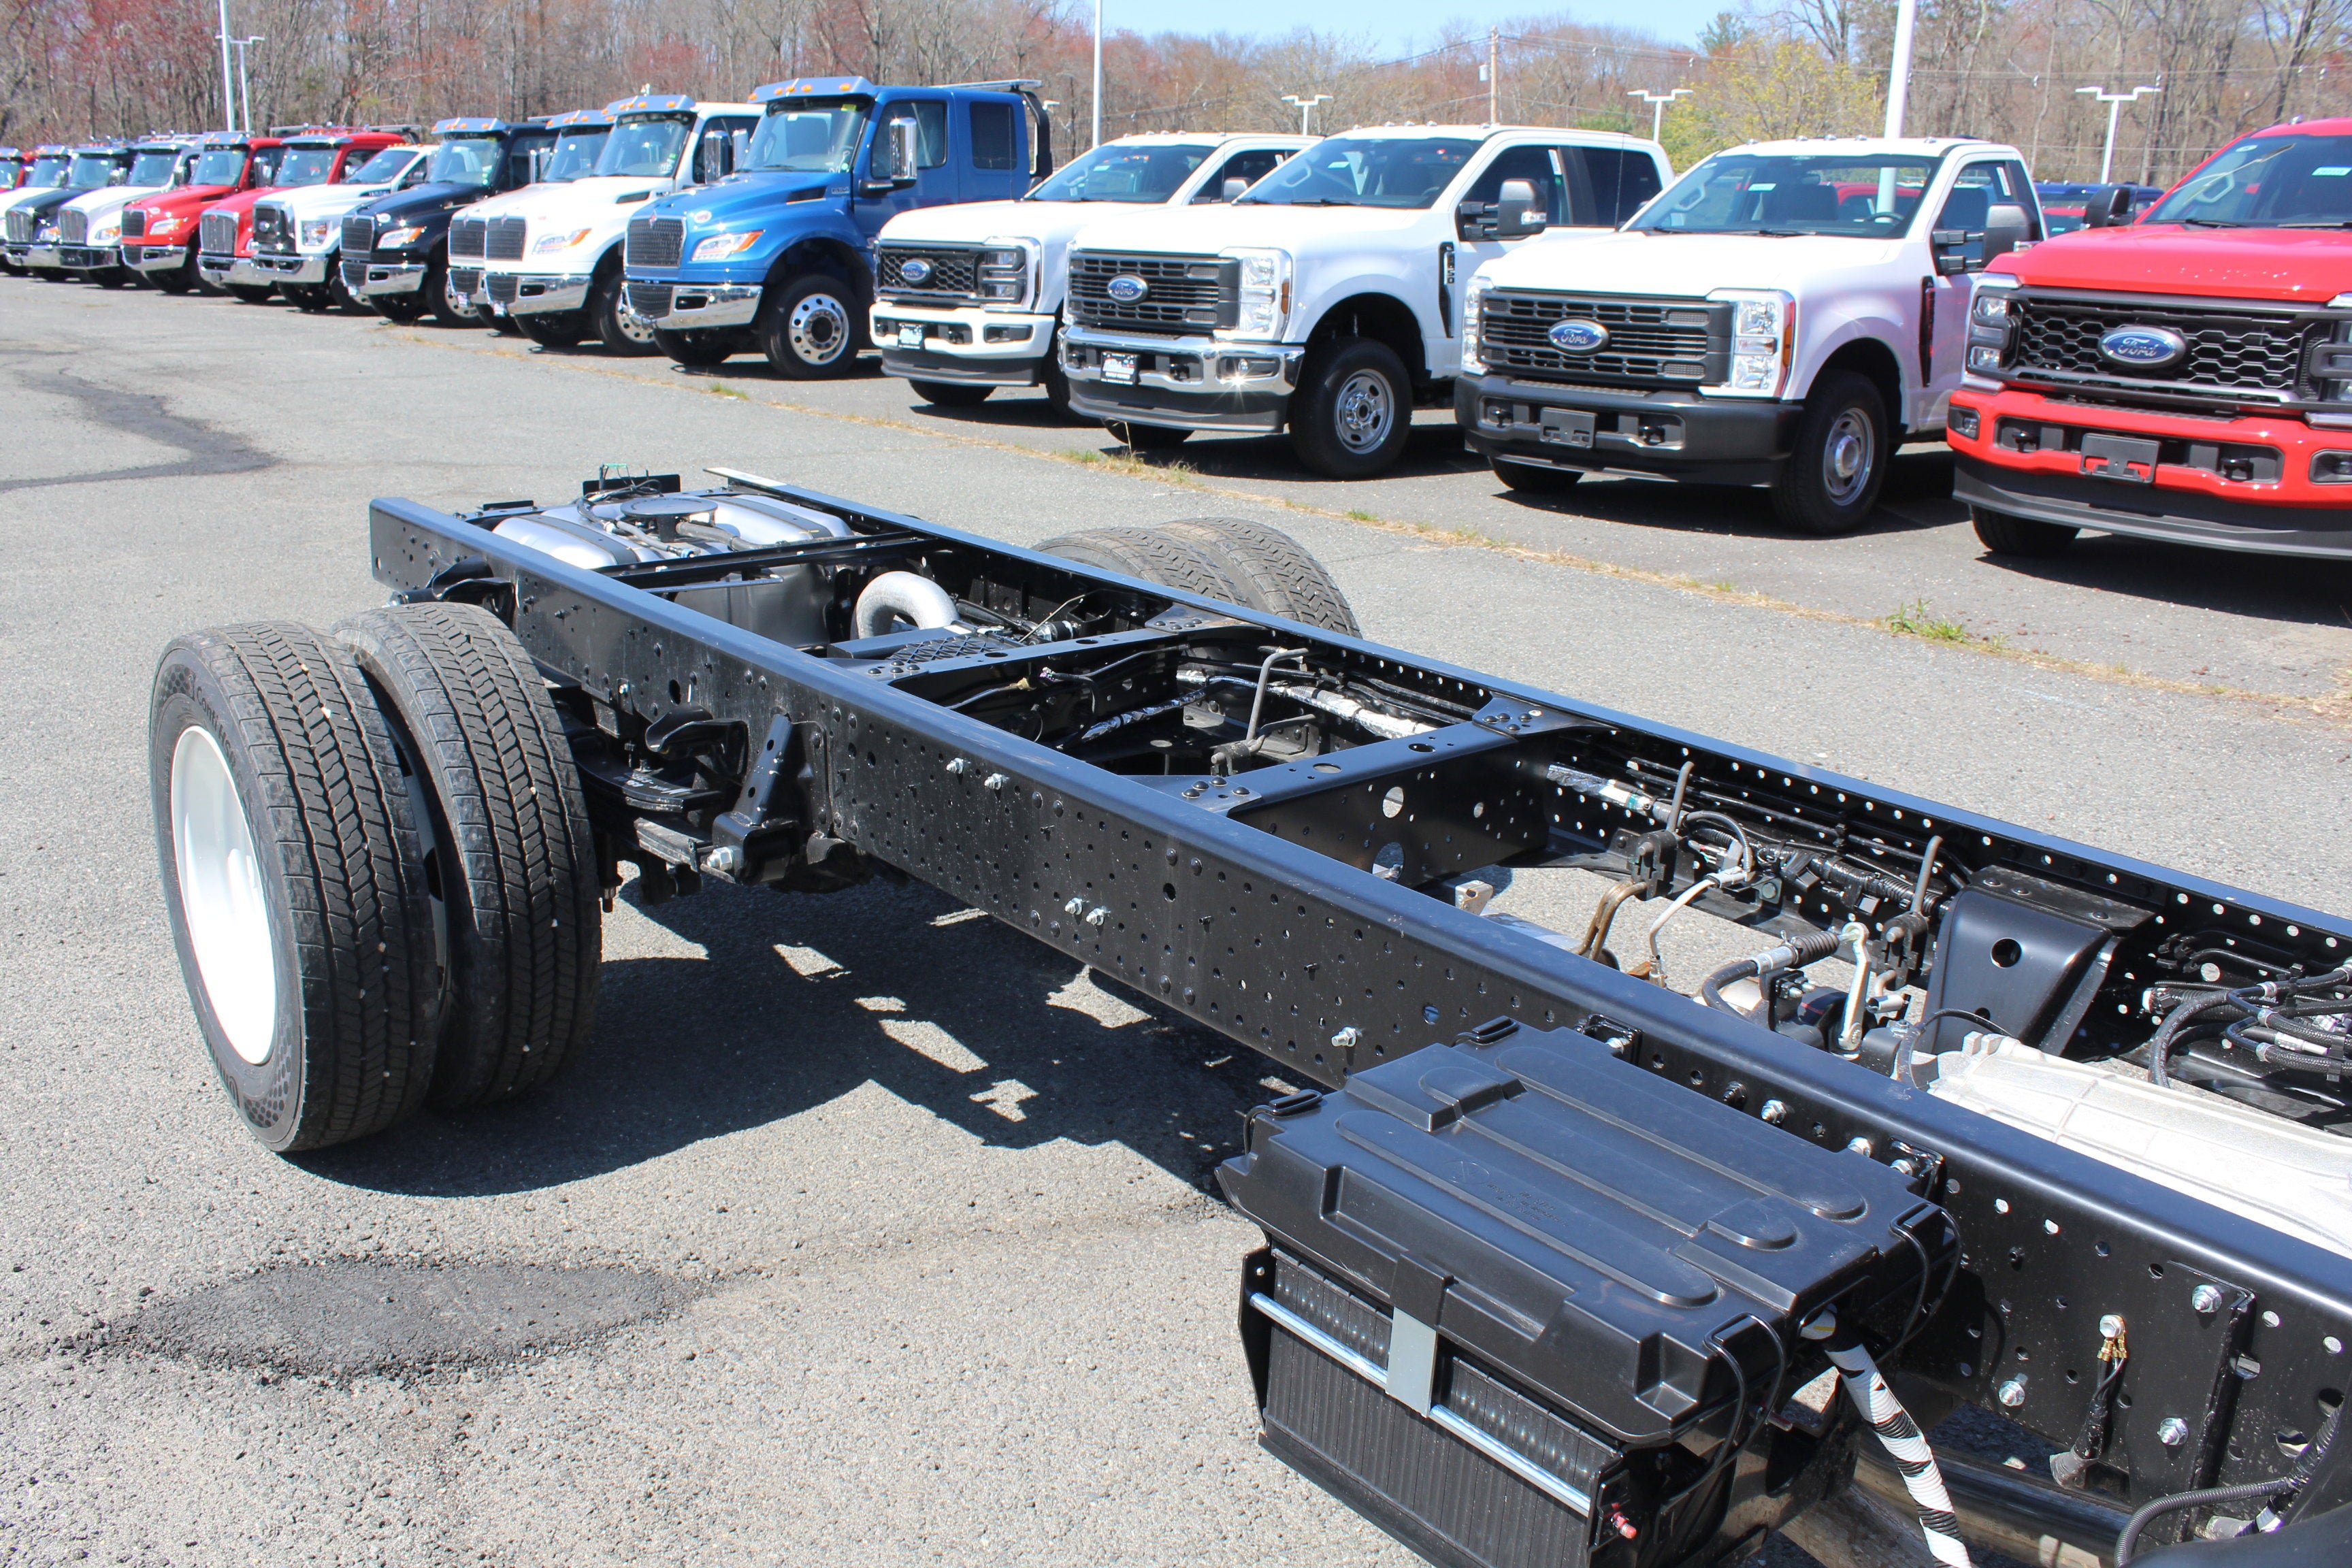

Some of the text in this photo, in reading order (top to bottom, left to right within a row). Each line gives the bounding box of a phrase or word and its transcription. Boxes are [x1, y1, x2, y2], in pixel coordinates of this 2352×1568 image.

[1561, 329, 1589, 344] Ford
[2117, 337, 2159, 357] Ford
[197, 686, 218, 730] Conti
